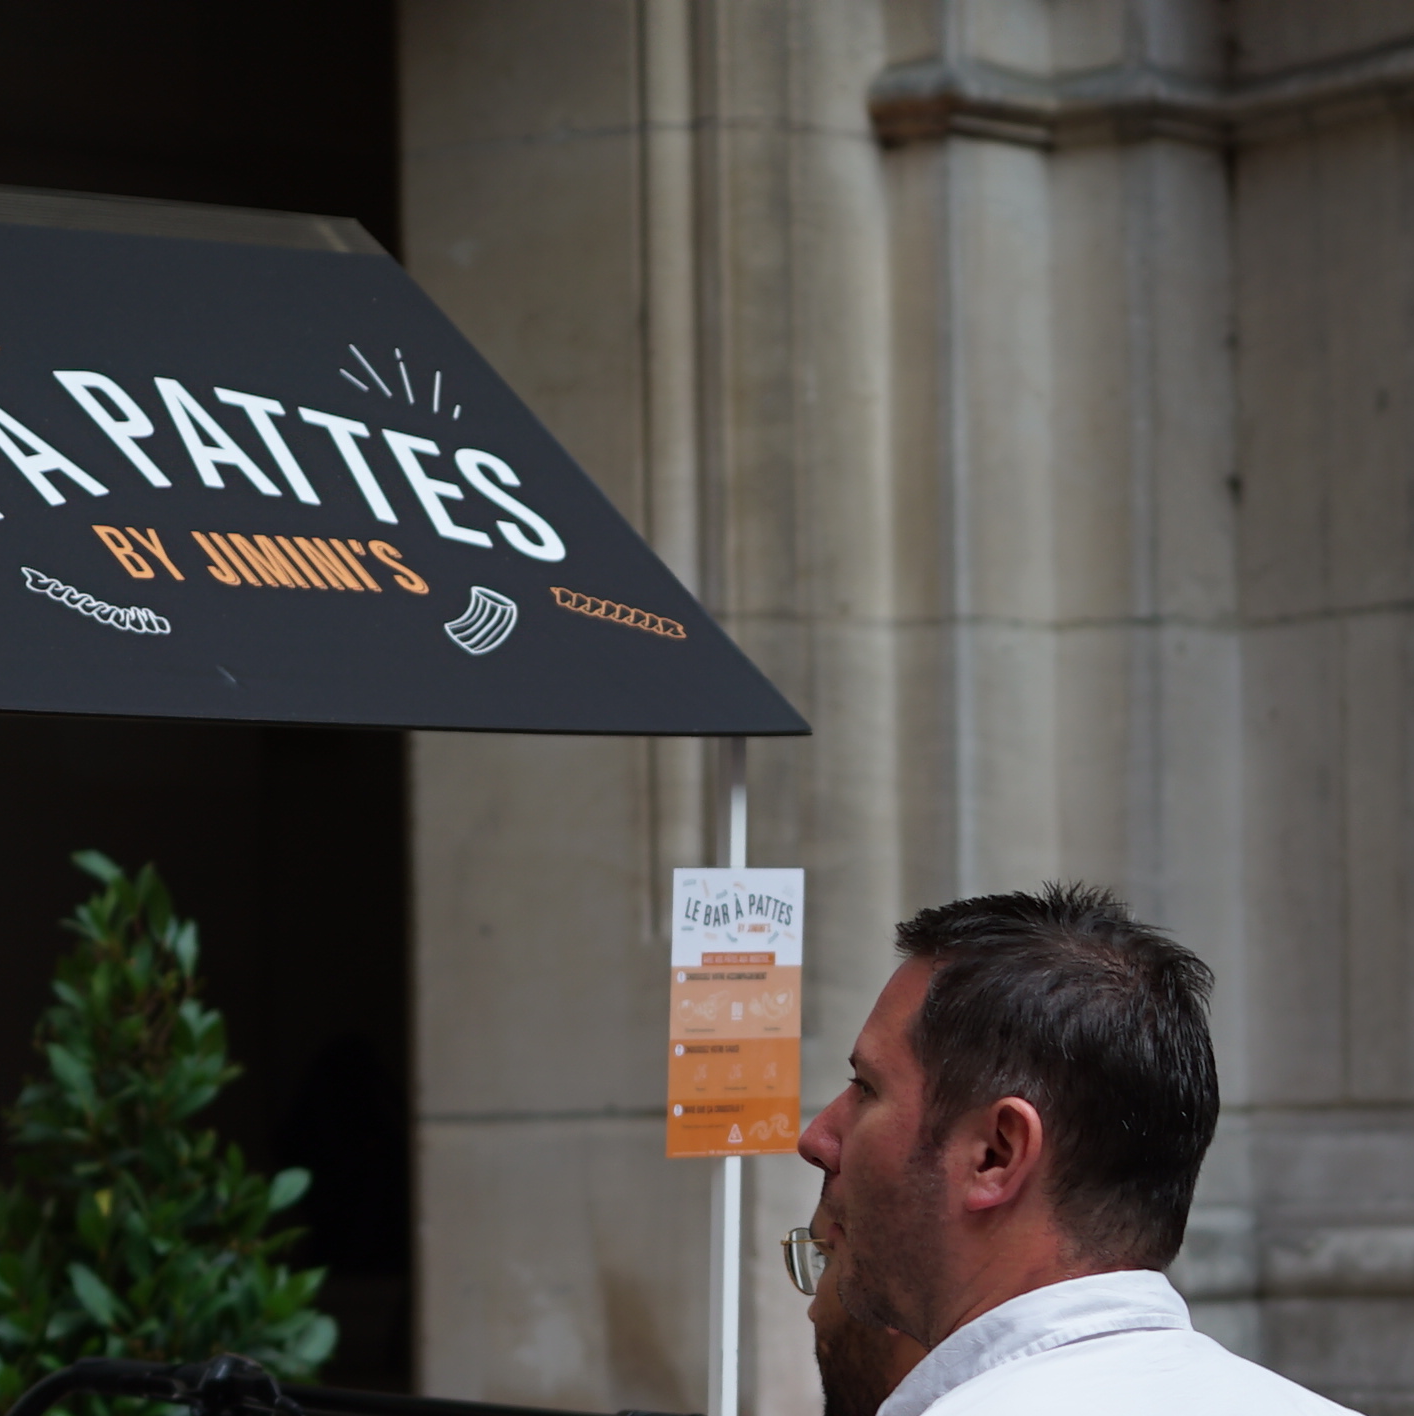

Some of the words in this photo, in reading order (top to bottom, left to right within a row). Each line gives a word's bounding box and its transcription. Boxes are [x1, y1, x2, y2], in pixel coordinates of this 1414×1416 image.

[52, 370, 567, 562] PATTES
[92, 525, 185, 583] BY
[188, 531, 430, 595] JIMINI'S
[685, 897, 701, 922] LE
[703, 903, 731, 927] BAR
[734, 893, 744, 920] À
[749, 894, 793, 926] PATTES
